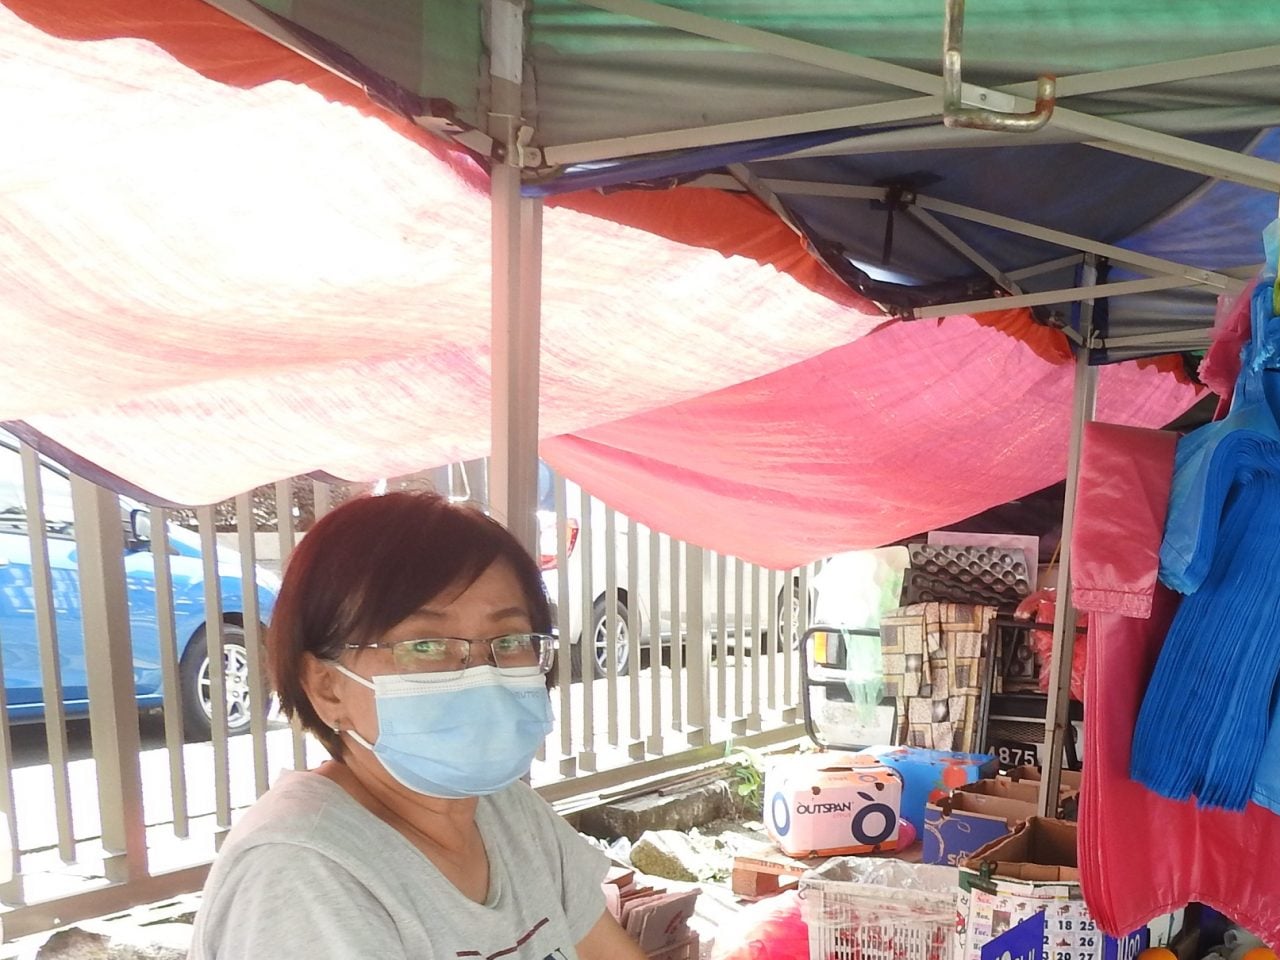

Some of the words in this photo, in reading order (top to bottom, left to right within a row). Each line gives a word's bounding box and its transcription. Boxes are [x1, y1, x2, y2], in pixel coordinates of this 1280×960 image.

[797, 801, 851, 815] OUTSPAN
[1058, 920, 1073, 931] 18
[1079, 921, 1095, 932] 25
[1079, 937, 1095, 948] 26
